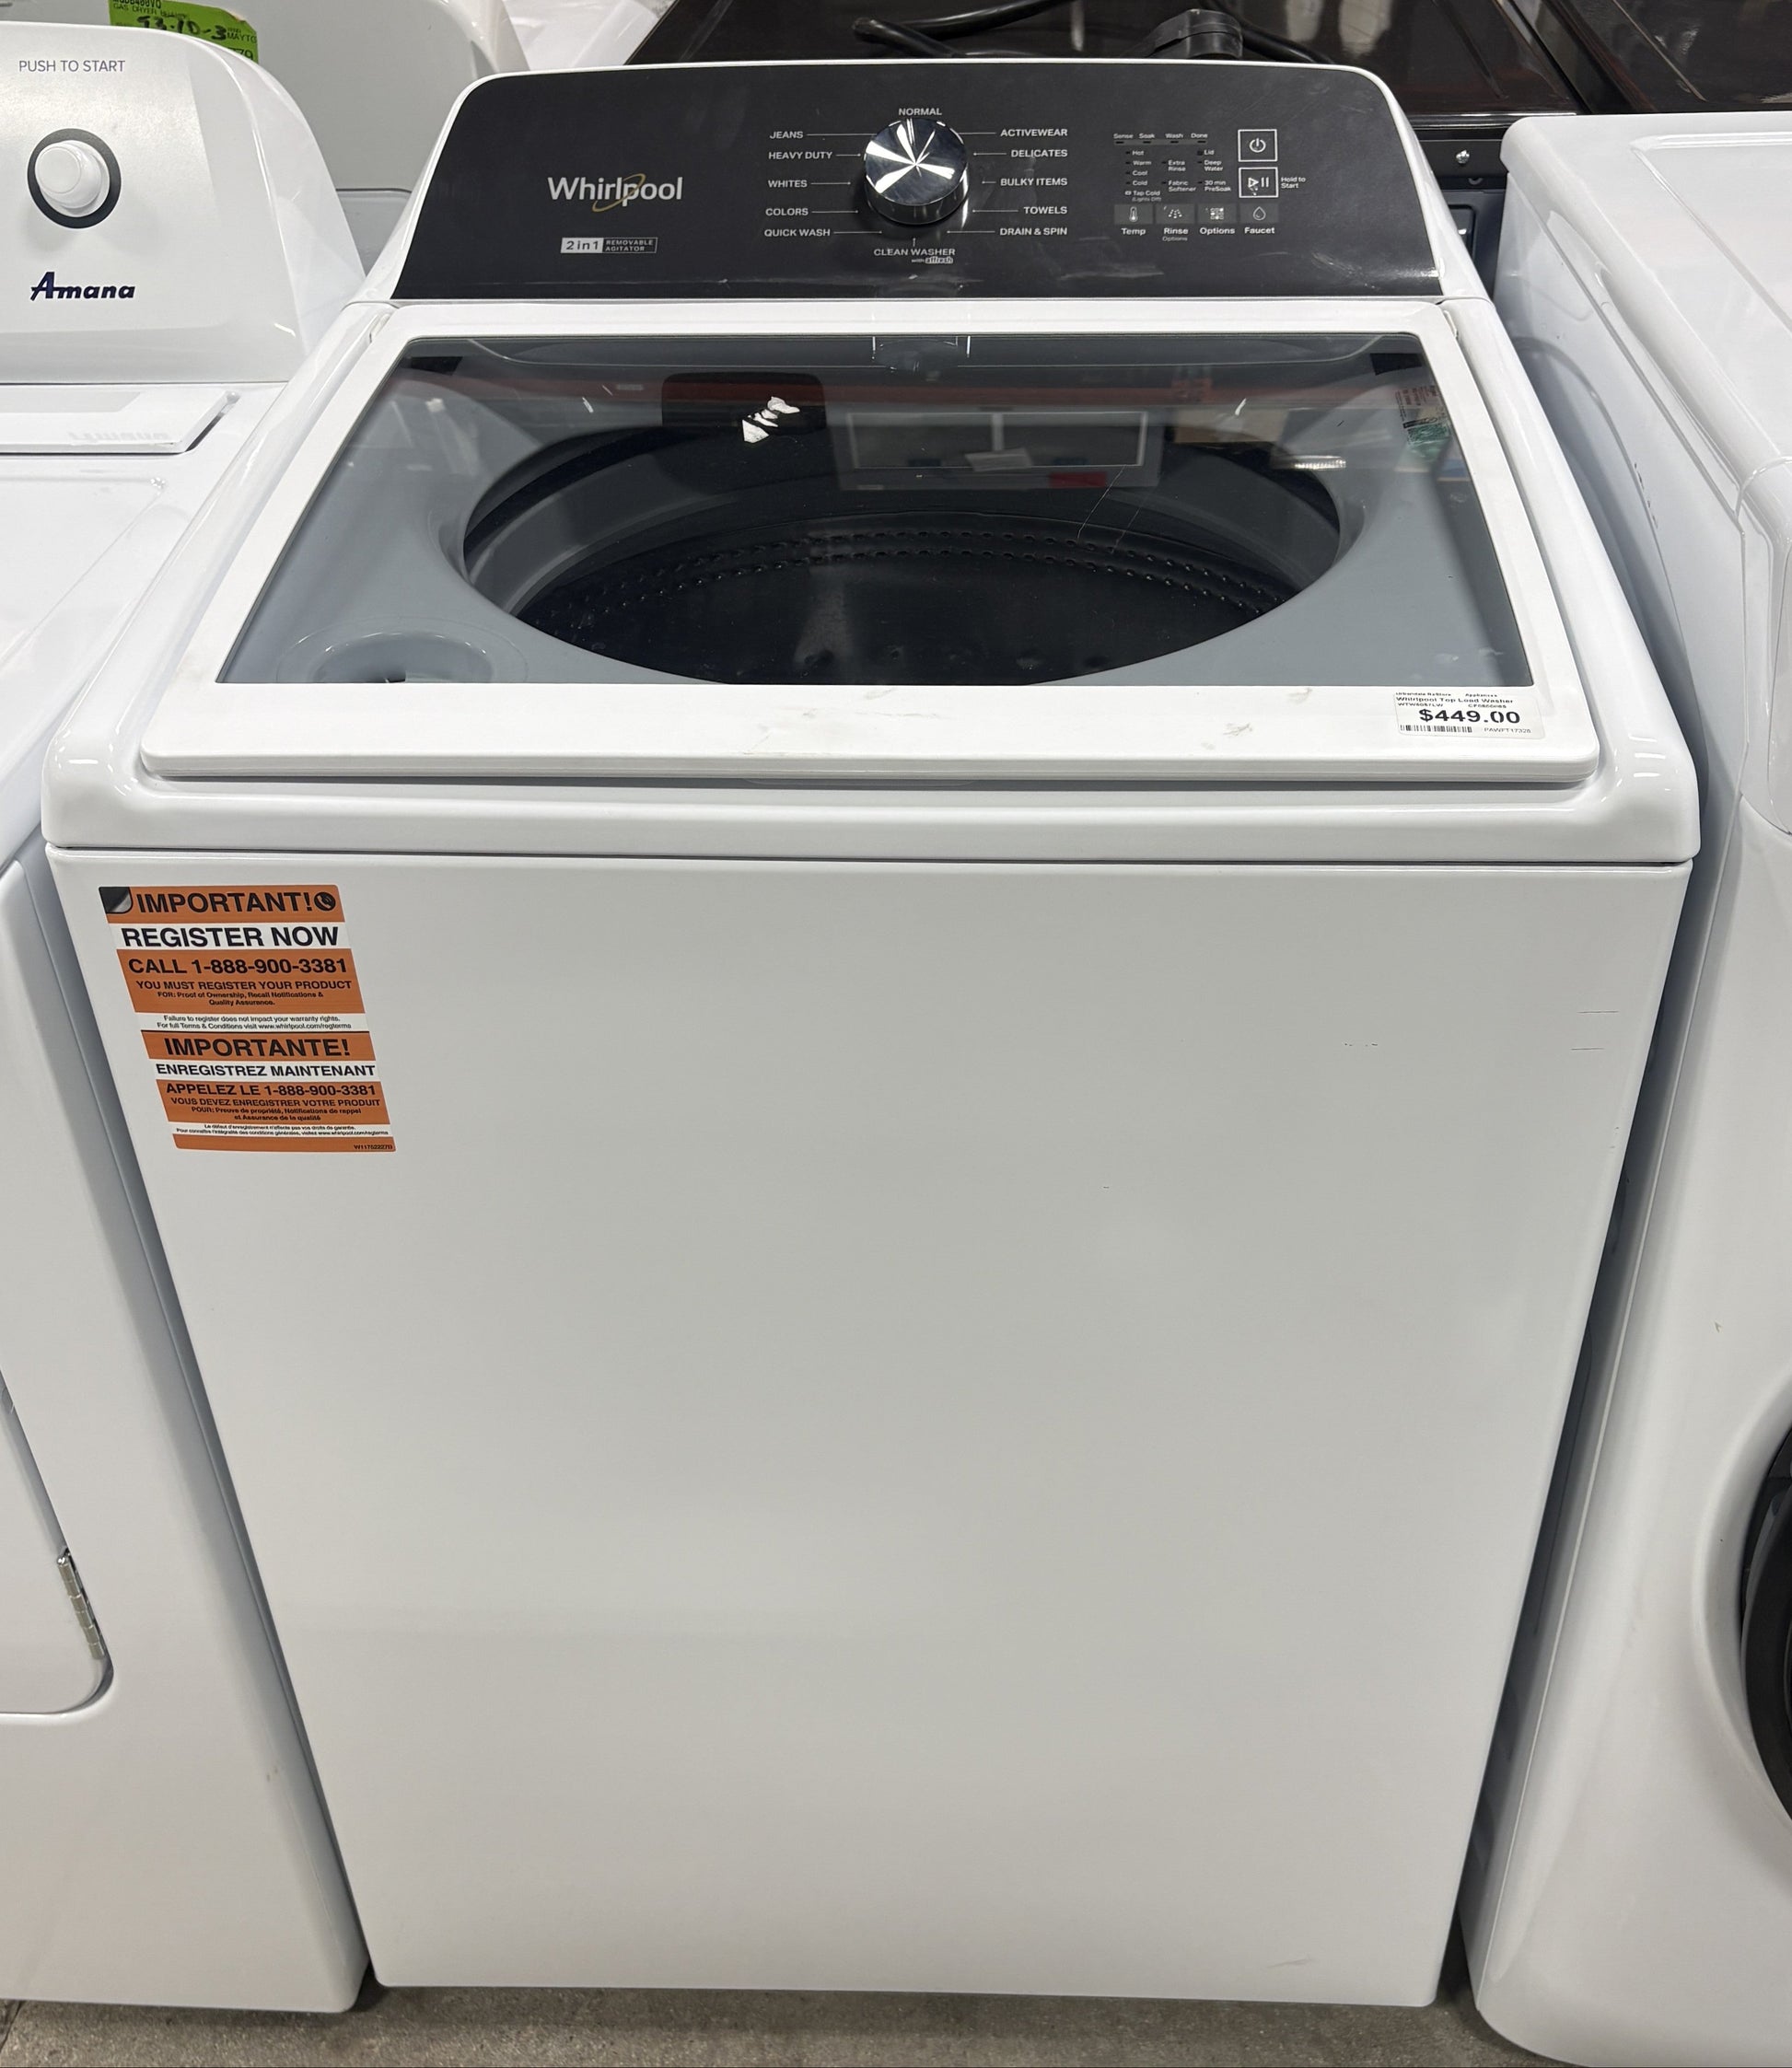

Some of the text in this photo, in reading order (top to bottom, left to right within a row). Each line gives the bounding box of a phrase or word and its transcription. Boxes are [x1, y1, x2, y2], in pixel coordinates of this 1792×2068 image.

[19, 61, 125, 72] PUSH TO START
[899, 108, 942, 116] NORMAL
[770, 131, 804, 139] JEANS
[1000, 129, 1068, 137] ACTIVEWEAR
[768, 151, 832, 160] HEAVY DUTY
[1011, 149, 1068, 157] DELICATES
[768, 180, 808, 188] WHITES
[1000, 178, 1068, 187] BULKY ITEMS
[547, 177, 683, 207] Whirlpool
[765, 208, 809, 216] COLORS
[1024, 206, 1068, 215] TOWELS
[764, 228, 831, 238] QUICK WASH
[1000, 228, 1031, 237] DRAIN
[1043, 227, 1068, 236] SPIN
[1122, 227, 1146, 236] Temp
[1200, 227, 1236, 236] Options
[30, 272, 135, 301] Amana
[1419, 709, 1520, 724] $449.00
[136, 892, 311, 913] IMPORTANT!
[122, 926, 338, 947] REGISTER NOW
[128, 958, 346, 974] CALL 1-888-900-3381
[136, 981, 352, 990] YOU MUST REGISTER YOUR PRODUCT
[164, 1038, 349, 1057] IMPORTANTE!
[157, 1064, 376, 1076] ENREGISTREZ MAINTENANT
[167, 1083, 376, 1096] APPELEZ LE 1-888-900-3381
